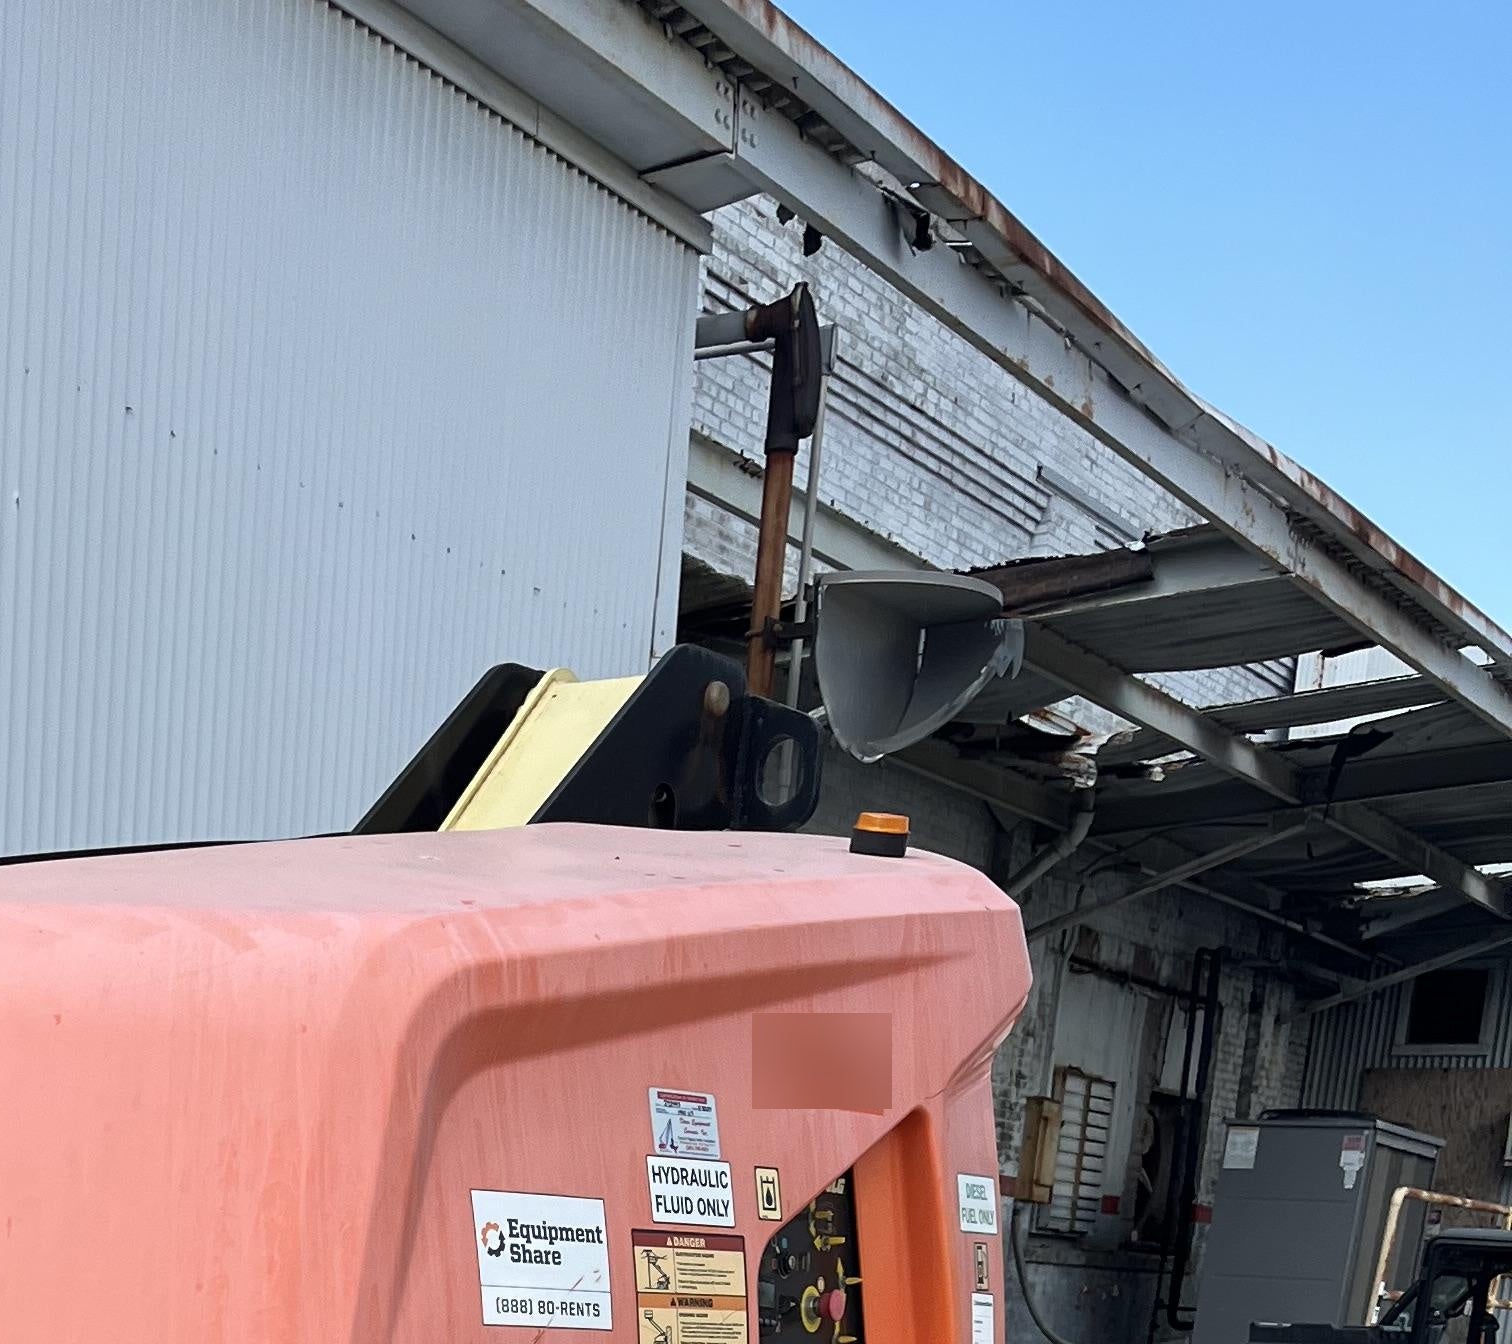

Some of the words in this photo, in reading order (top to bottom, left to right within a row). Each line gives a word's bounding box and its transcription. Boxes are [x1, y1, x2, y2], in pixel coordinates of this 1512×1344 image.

[651, 1165, 729, 1189] HYDRAULIC
[826, 1178, 846, 1194] LG
[965, 1183, 988, 1200] DIESEL
[655, 1194, 694, 1215] FLUID
[697, 1198, 731, 1217] ONLY
[962, 1207, 977, 1224] FUEL
[979, 1210, 995, 1225] ONLY
[506, 1218, 604, 1245] Equipment
[673, 1237, 707, 1248] DANGER
[509, 1243, 562, 1266] Share
[496, 1296, 534, 1315] (888)
[538, 1300, 601, 1318] 80-RENTS
[677, 1297, 713, 1308] WARNING
